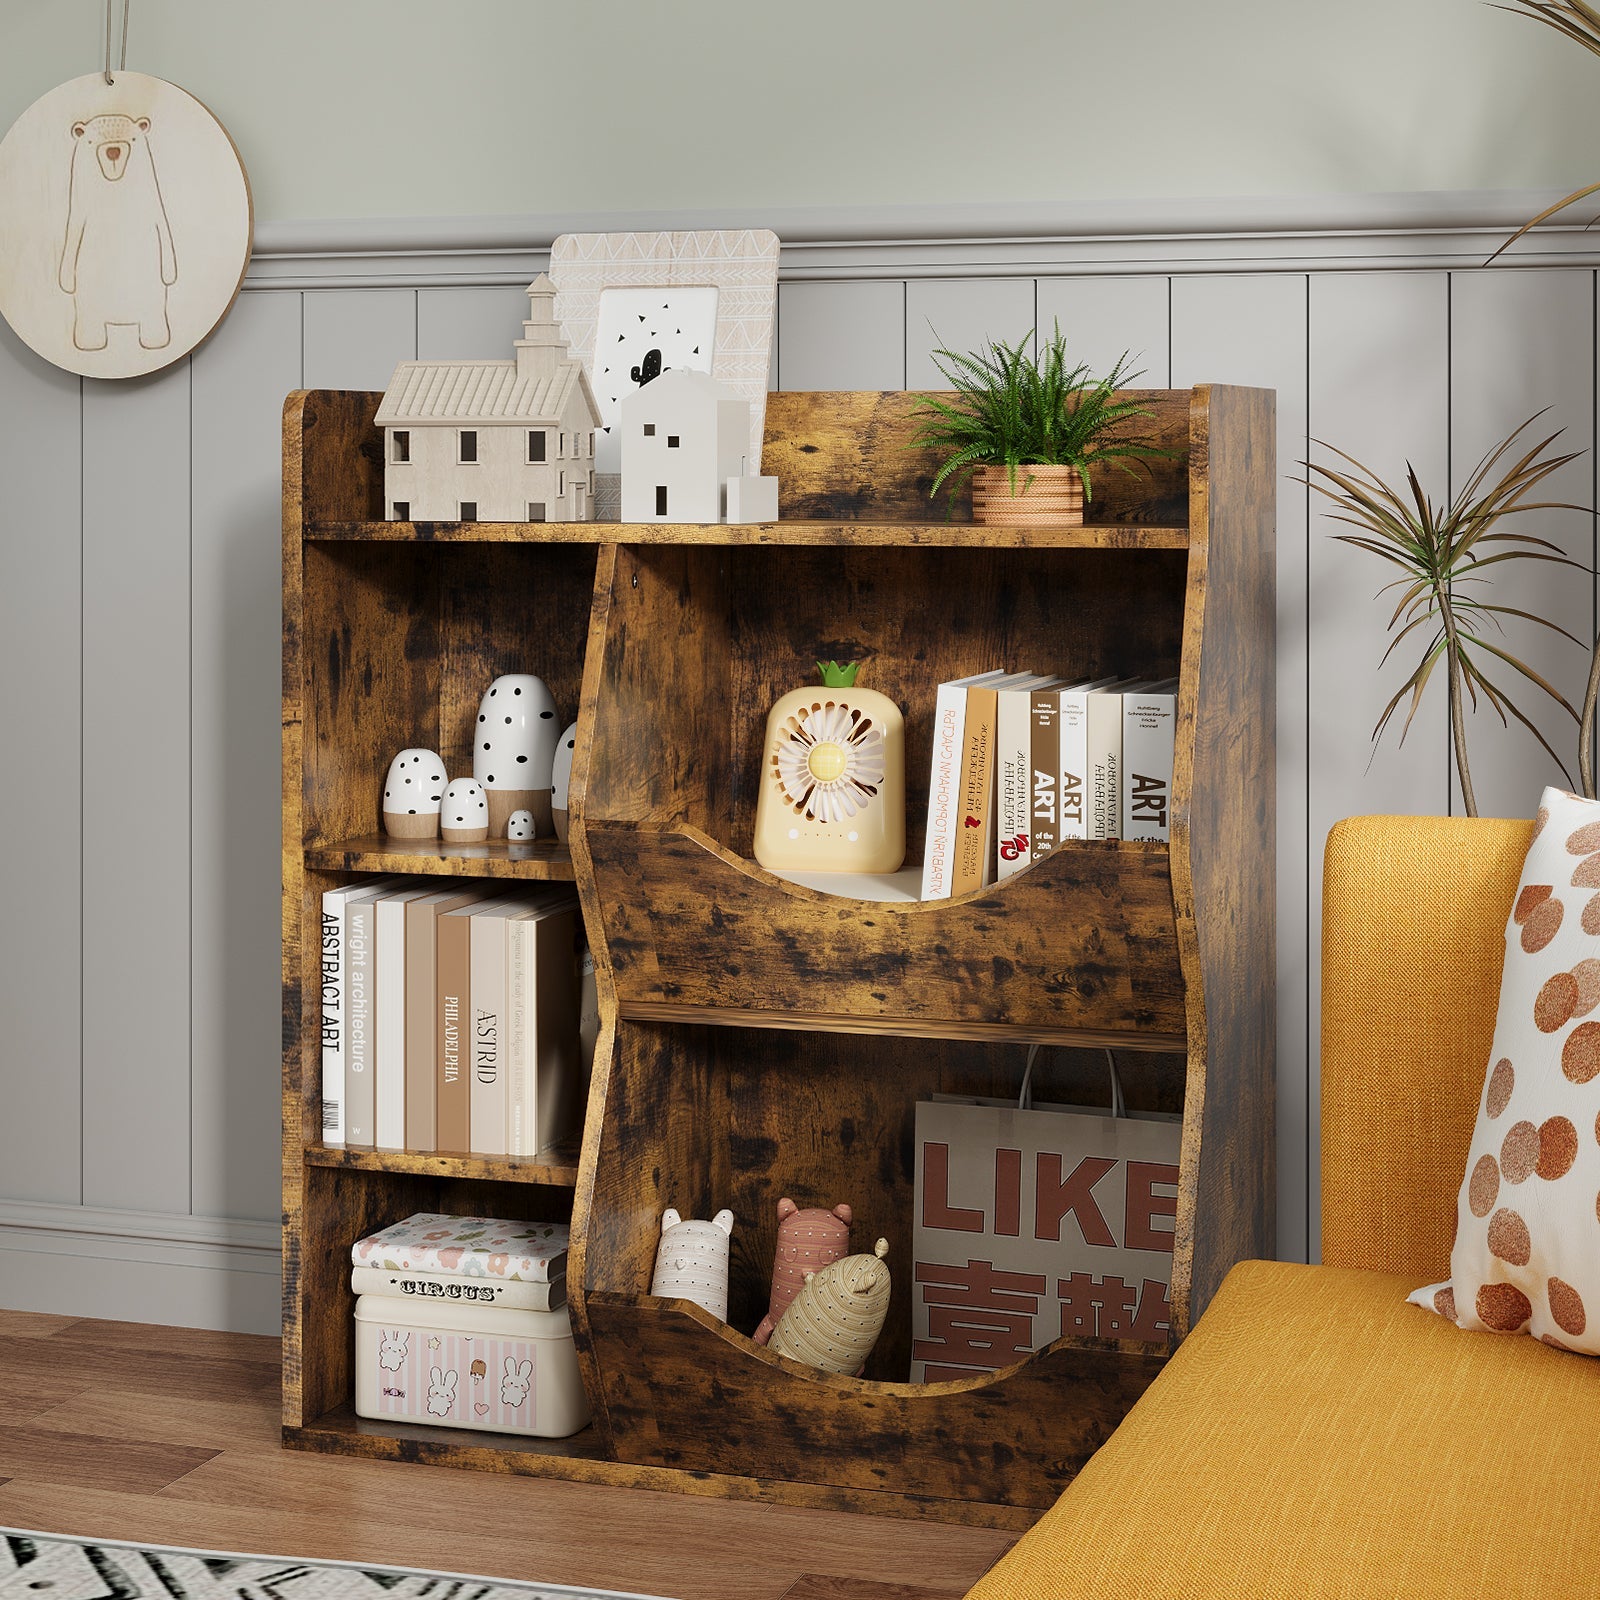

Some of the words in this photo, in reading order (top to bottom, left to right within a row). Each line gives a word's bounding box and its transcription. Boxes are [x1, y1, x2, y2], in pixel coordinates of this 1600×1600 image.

[1034, 769, 1056, 824] ART
[1064, 771, 1082, 824] ART
[1131, 773, 1166, 827] ART
[322, 912, 340, 1011] ABSTRACT
[350, 914, 368, 966] wright
[322, 1014, 340, 1052] ART
[352, 972, 368, 1072] architecture
[445, 996, 459, 1083] PHILADELPHIA
[922, 1141, 1180, 1252] LIKE
[400, 1279, 495, 1301] CIRCUS
